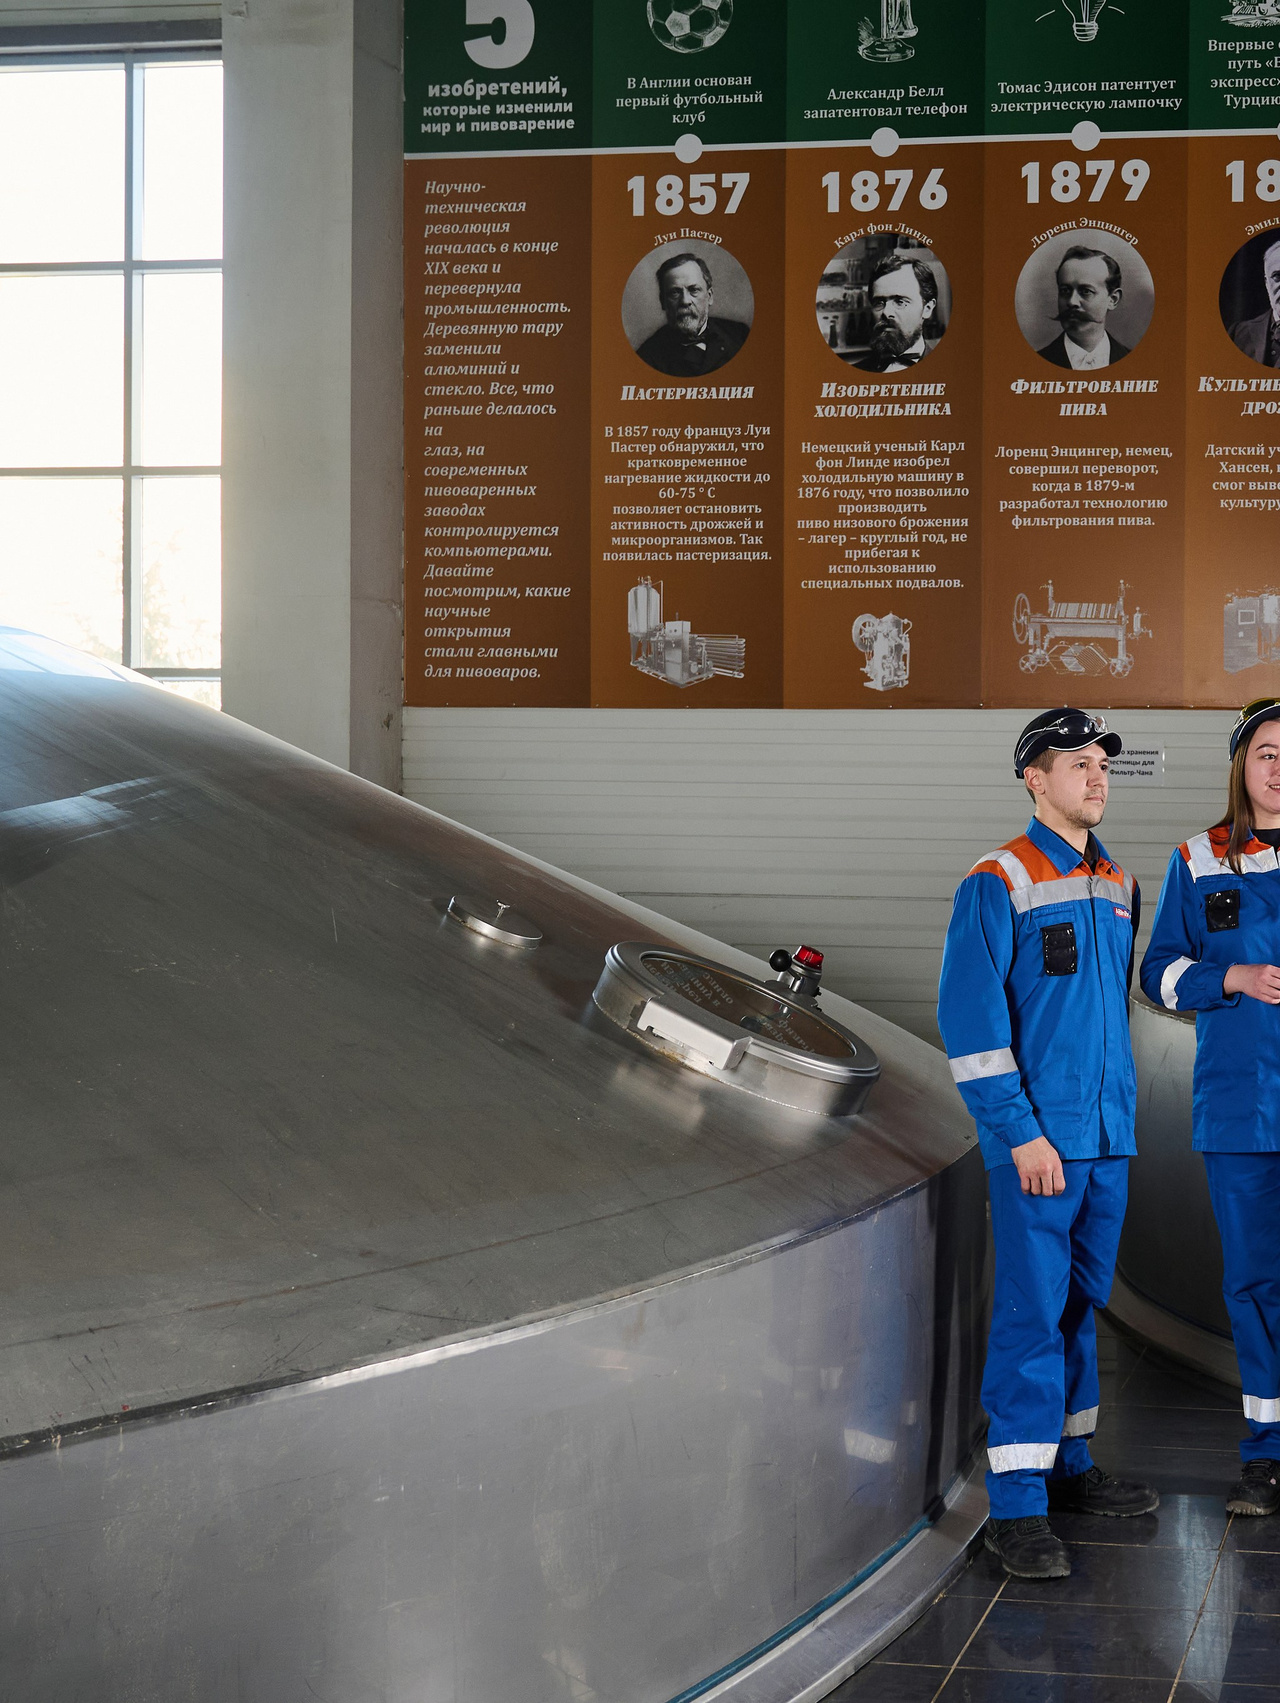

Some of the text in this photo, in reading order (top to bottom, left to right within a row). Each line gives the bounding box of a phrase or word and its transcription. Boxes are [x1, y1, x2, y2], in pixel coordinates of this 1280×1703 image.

[1208, 40, 1274, 54] Впервые
[1228, 60, 1262, 72] путь
[428, 76, 567, 100] изобретений,
[627, 76, 751, 89] В Англии основан
[997, 80, 1176, 94] Томас Эдисон патентует
[616, 91, 763, 110] первый футбольный
[827, 86, 944, 101] Александр Белл
[423, 102, 572, 119] которые изменили
[804, 102, 967, 119] запатентовал телефон
[991, 98, 1182, 114] электрическую лампочку
[673, 111, 705, 126] клуб
[421, 119, 575, 136] мир и пивоварение
[1022, 159, 1150, 204] 1879
[425, 181, 486, 197] Научно-
[627, 173, 750, 217] 1857
[822, 168, 948, 212] 1876
[425, 202, 526, 214] техническая
[424, 223, 510, 238] революция
[654, 228, 722, 246] Луи Пастер
[834, 222, 933, 249] Карл фон Линде
[1031, 217, 1139, 249] Лоренц Энцингер
[425, 283, 521, 298] перевернула
[425, 303, 571, 318] промышленность.
[423, 322, 564, 338] Деревянную тару
[424, 344, 501, 355] заменили
[424, 402, 556, 419] раньше делалось
[611, 441, 764, 455] Пастер обнаружил, что
[802, 440, 965, 455] Немецкий ученый Карл
[995, 446, 1173, 460] Лоренц Энцингер, немец,
[1205, 444, 1265, 457] Датский
[628, 458, 747, 471] кратковременное
[1009, 465, 1158, 477] совершил переворот,
[424, 466, 528, 479] современных
[424, 486, 537, 499] пивоваренных
[424, 503, 486, 516] заводах
[613, 505, 762, 514] позволяет остановить
[838, 504, 927, 516] производить
[1000, 497, 1168, 512] разработал технологию
[1012, 515, 1155, 529] фильтрования пива.
[425, 526, 559, 540] контролируется
[612, 533, 763, 548] микроорганизмов. Так
[424, 547, 552, 560] компьютерами.
[603, 552, 772, 563] появилась пастеризация.
[423, 564, 494, 580] Давайте
[829, 564, 936, 573] использованию
[801, 579, 964, 590] специальных подвалов.
[425, 587, 571, 600] посмотрим, какие
[425, 607, 491, 620] научные
[424, 627, 511, 641] открытия
[424, 647, 558, 658] стали главными
[424, 664, 540, 681] для пивоваров.
[1109, 769, 1154, 777] Фильтр-Чана
